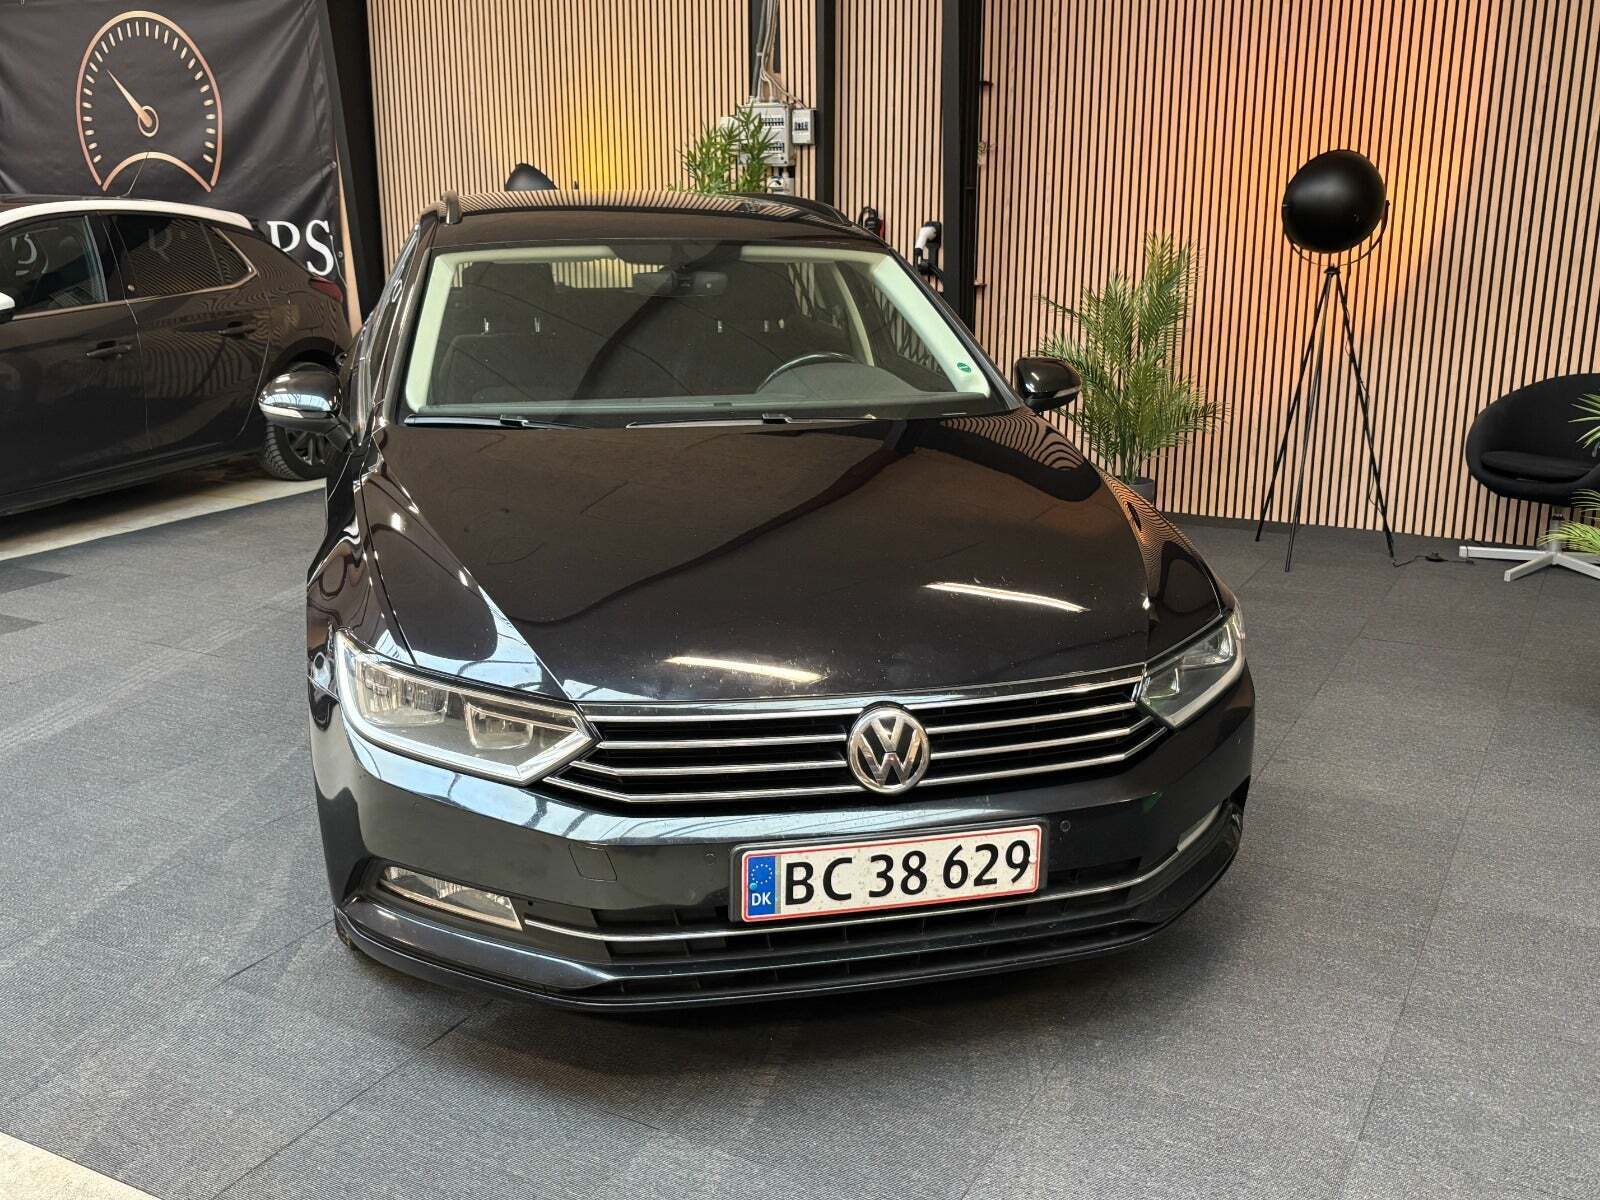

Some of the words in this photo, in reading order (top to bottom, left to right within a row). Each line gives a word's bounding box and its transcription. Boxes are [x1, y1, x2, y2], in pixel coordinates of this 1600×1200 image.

[853, 711, 925, 789] VW
[751, 891, 772, 907] DK
[785, 857, 853, 906] BC
[868, 850, 929, 898] 38
[942, 839, 1032, 890] 629
